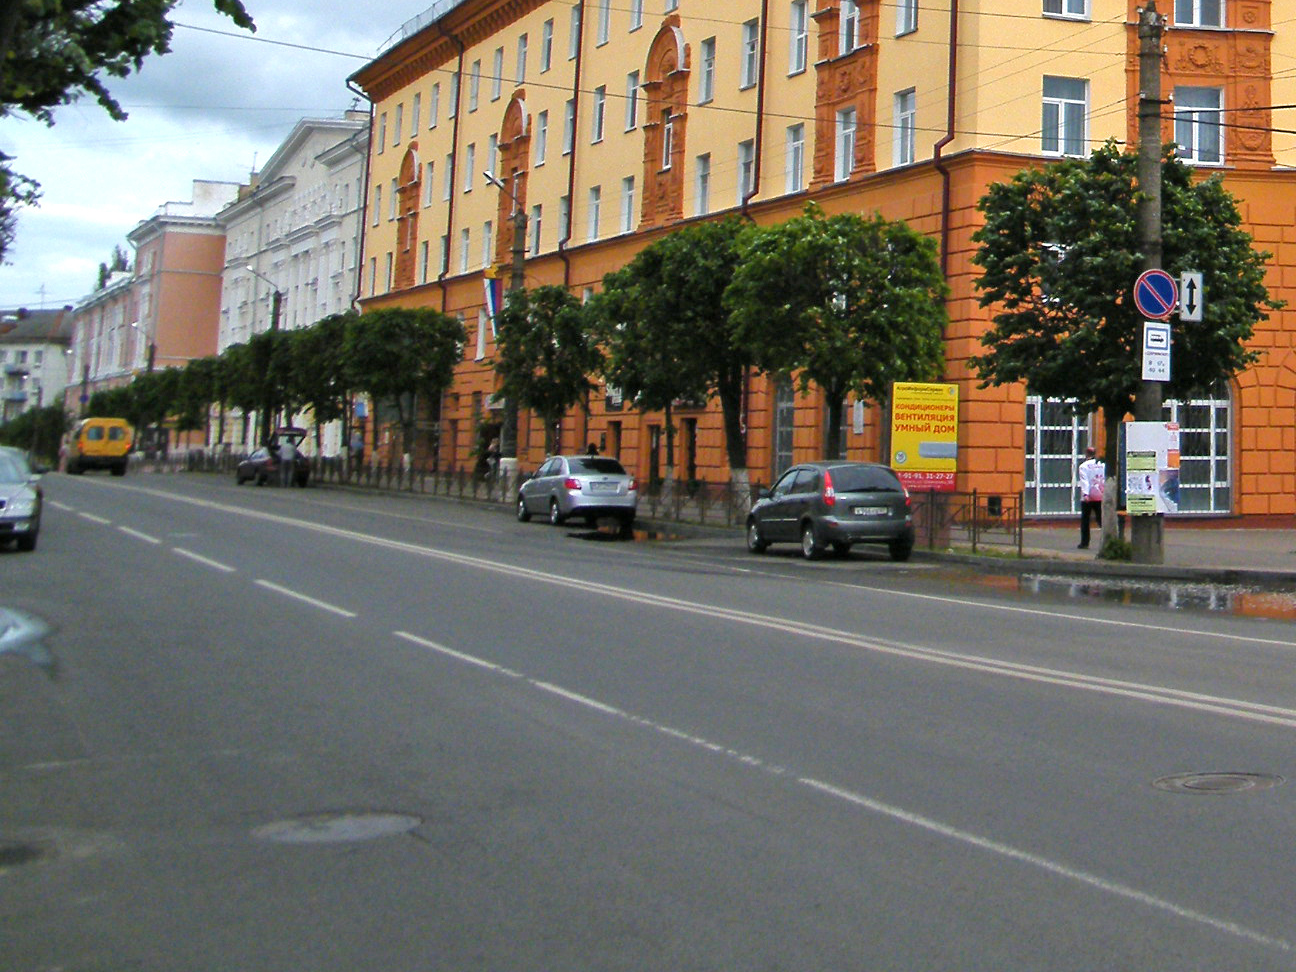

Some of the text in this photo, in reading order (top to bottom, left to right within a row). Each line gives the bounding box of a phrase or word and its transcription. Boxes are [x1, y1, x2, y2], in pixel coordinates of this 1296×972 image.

[895, 403, 955, 412] КОНДИЦИОНЕРЫ
[895, 413, 955, 422] ВЕНТИЛЯЦИЯ
[895, 423, 955, 434] УМНЫЙ ДОМ
